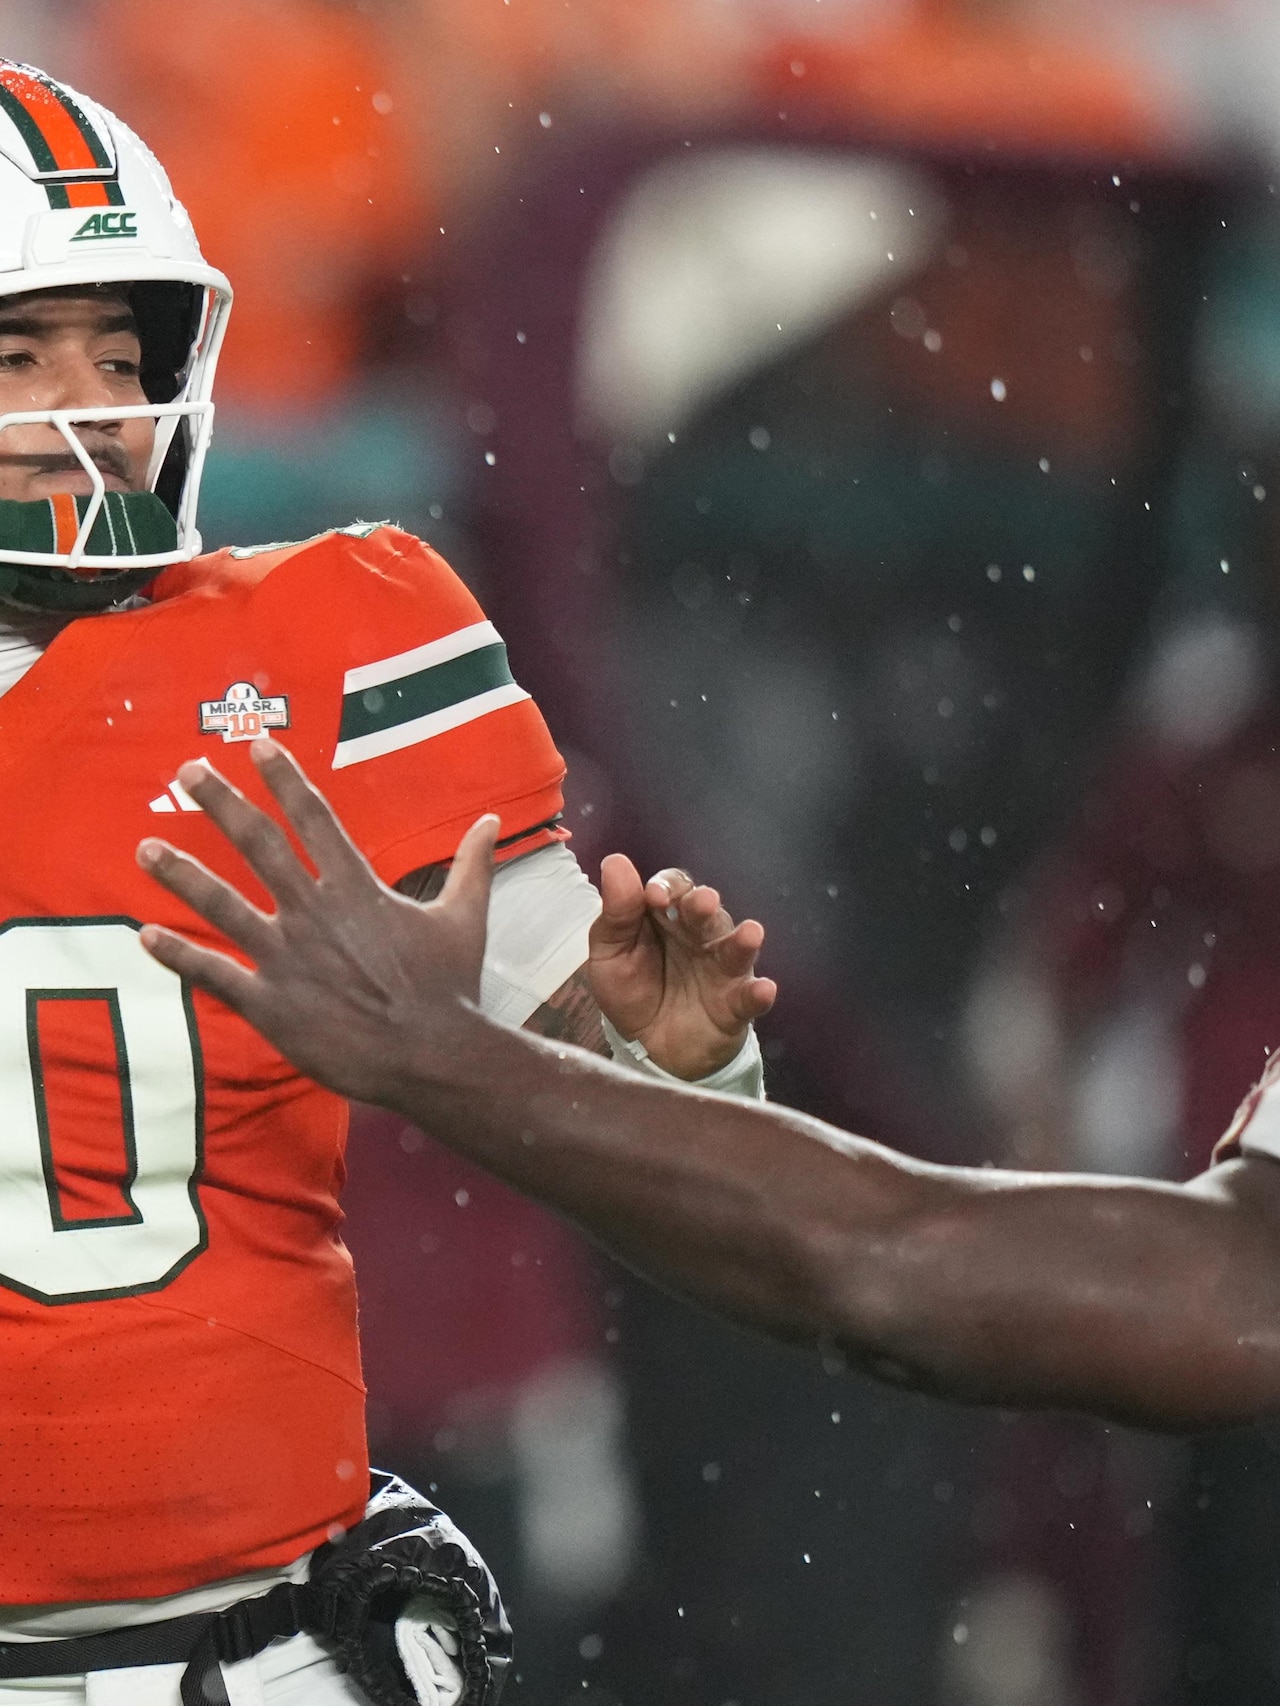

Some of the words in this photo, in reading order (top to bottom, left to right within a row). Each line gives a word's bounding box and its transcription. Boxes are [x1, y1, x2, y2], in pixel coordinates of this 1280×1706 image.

[74, 212, 138, 236] ACC
[233, 688, 250, 699] U
[210, 703, 248, 714] MIRA
[252, 701, 276, 711] SR.
[229, 712, 261, 738] 10
